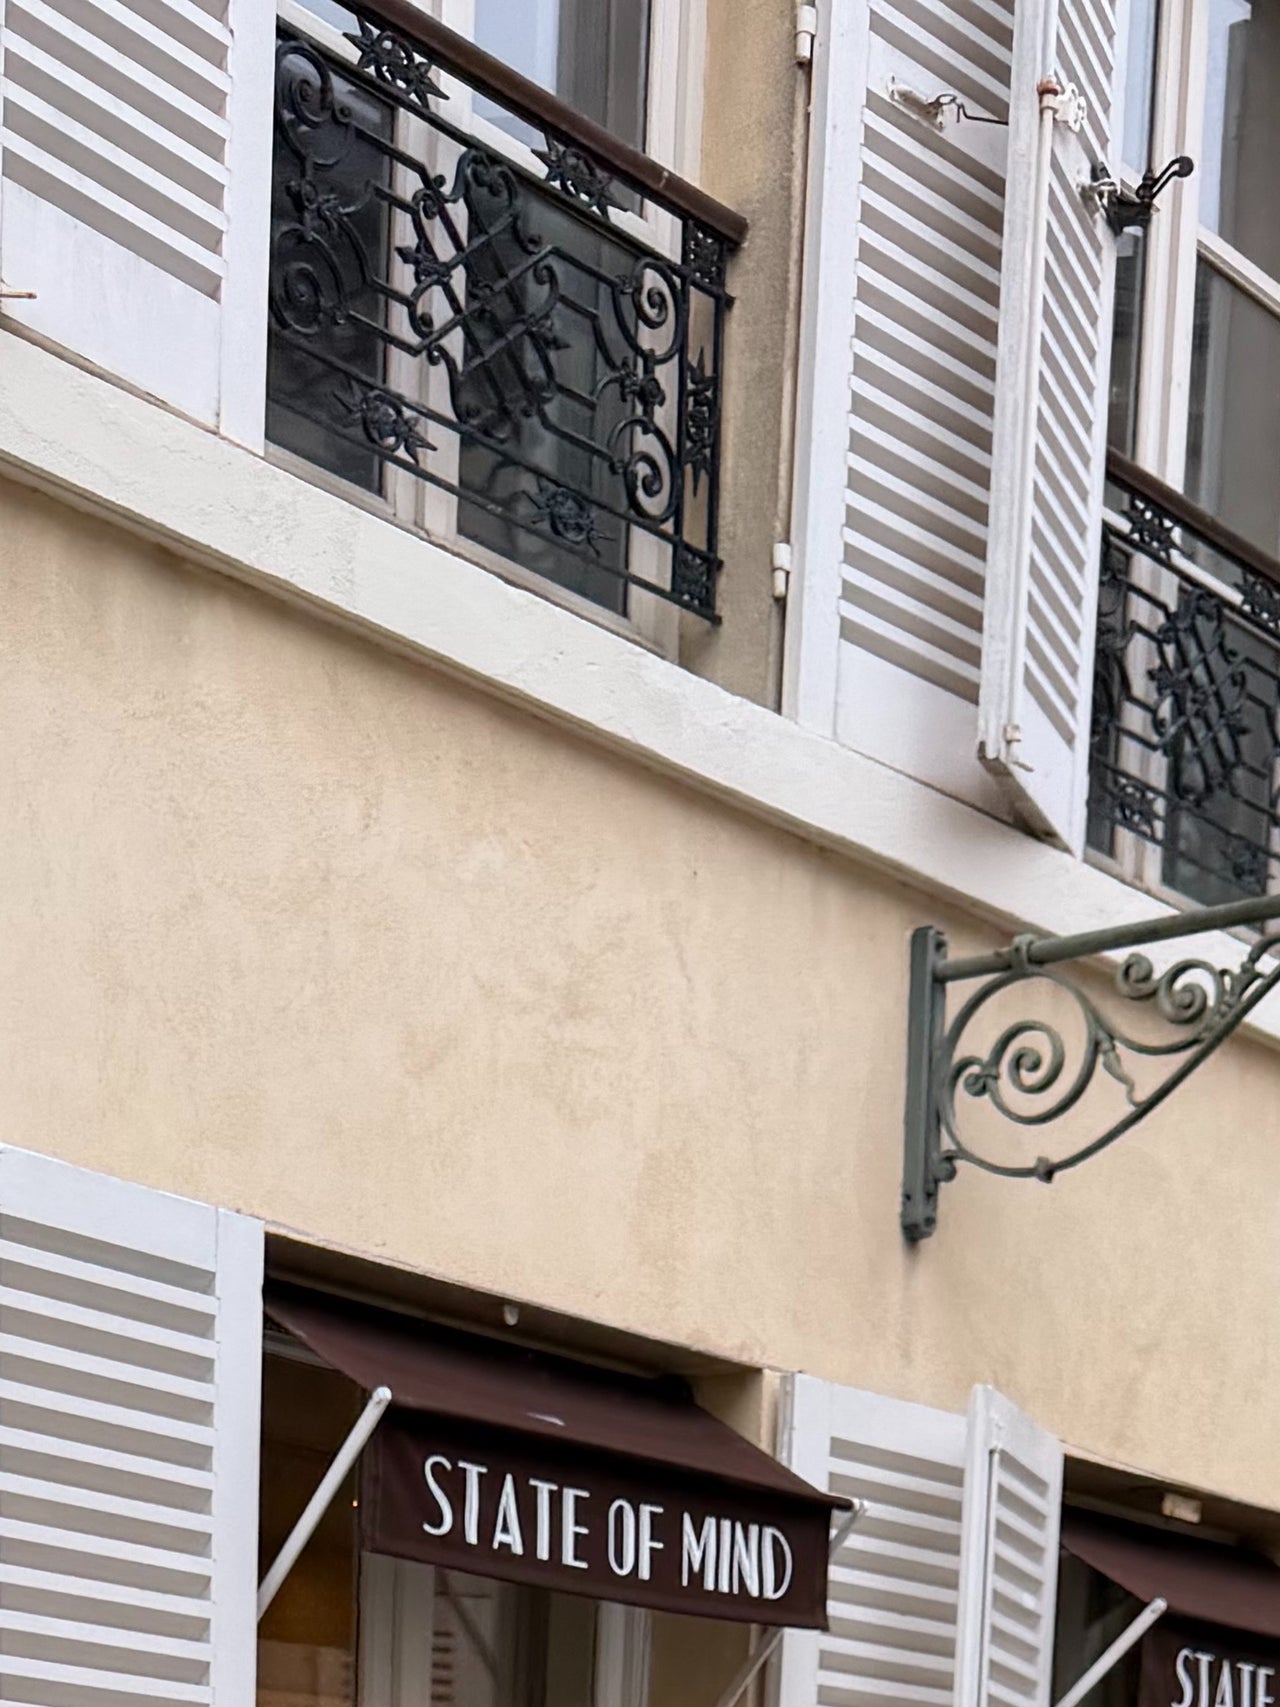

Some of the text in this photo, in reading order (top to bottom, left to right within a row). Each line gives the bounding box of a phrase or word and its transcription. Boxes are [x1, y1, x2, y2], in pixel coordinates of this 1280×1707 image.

[422, 1455, 793, 1600] STATE OF MIND
